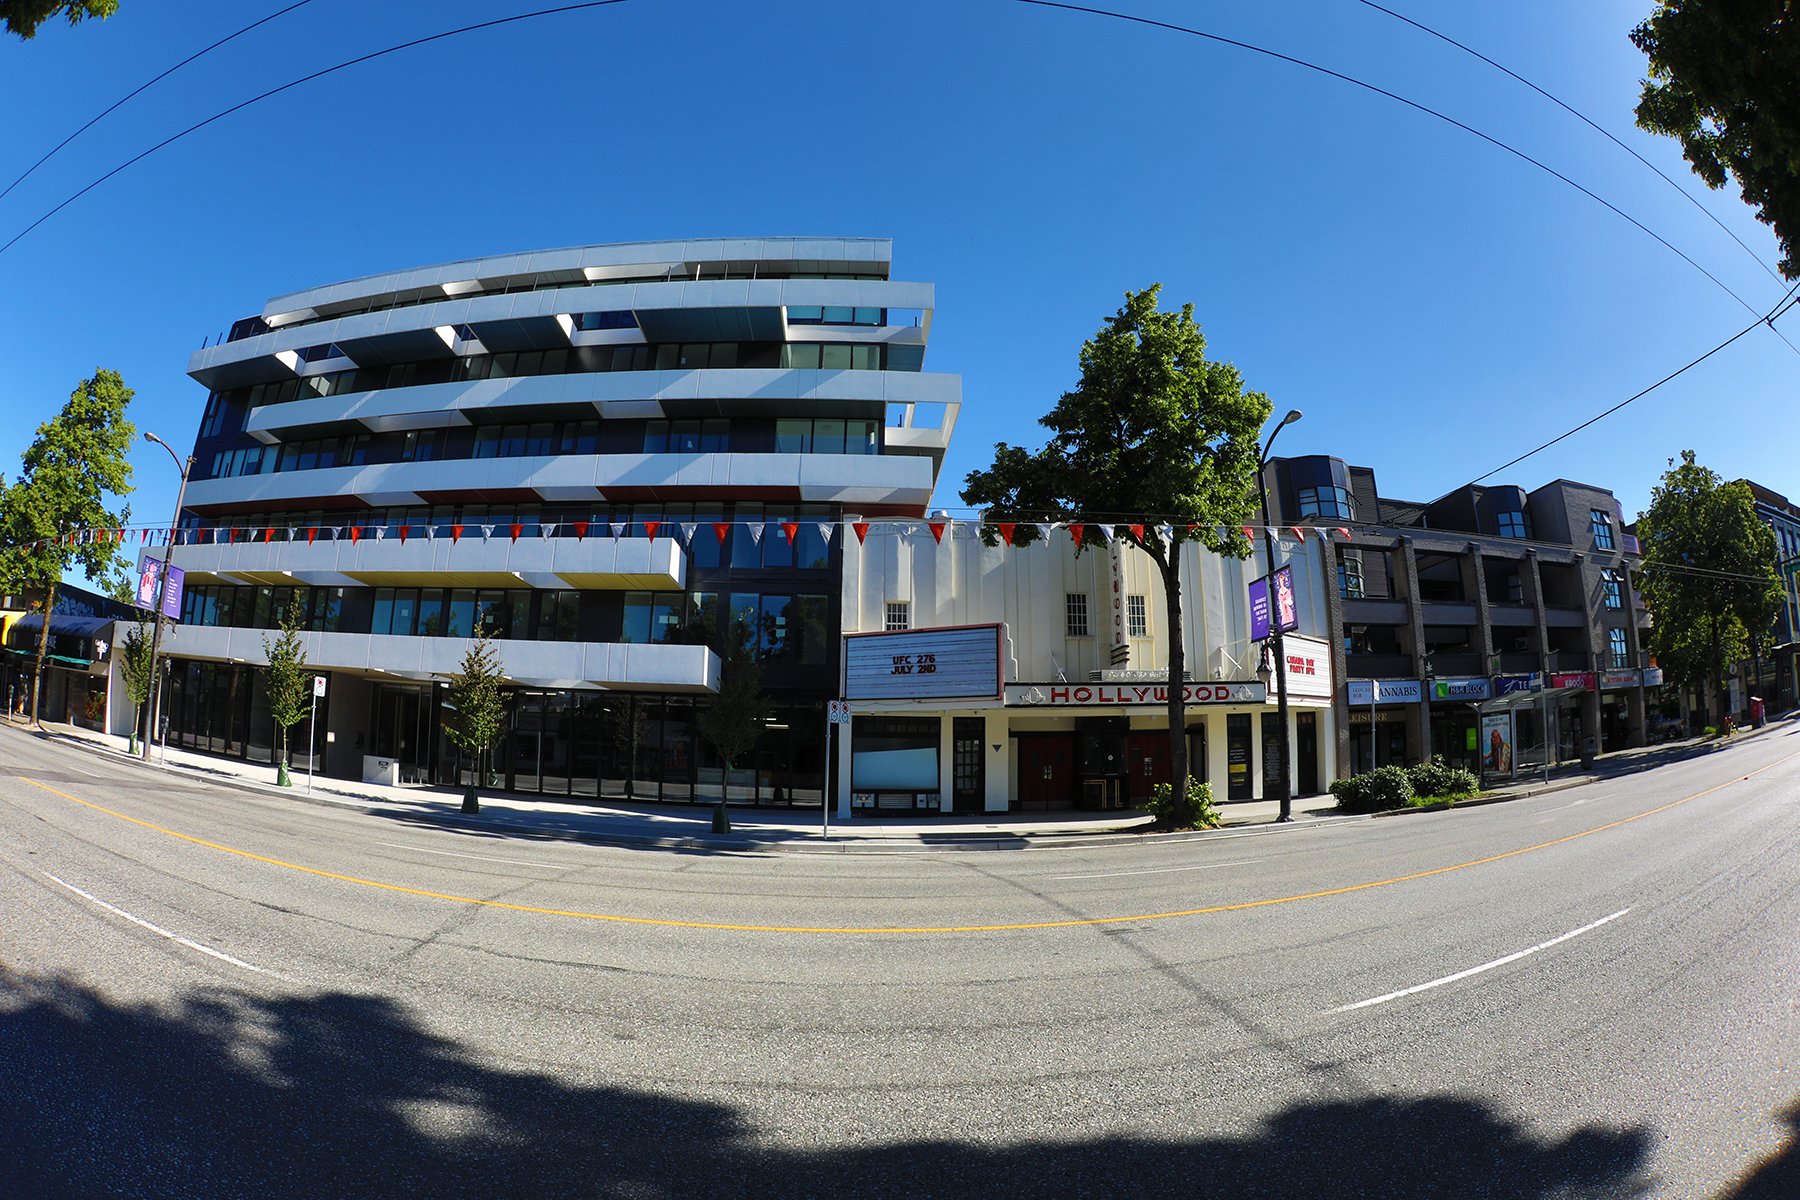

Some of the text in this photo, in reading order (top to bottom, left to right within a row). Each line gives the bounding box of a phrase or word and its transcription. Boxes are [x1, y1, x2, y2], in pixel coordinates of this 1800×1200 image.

[893, 654, 936, 665] UFC 276
[891, 664, 937, 675] JULY 2ND
[1379, 686, 1418, 697] ANNABIS
